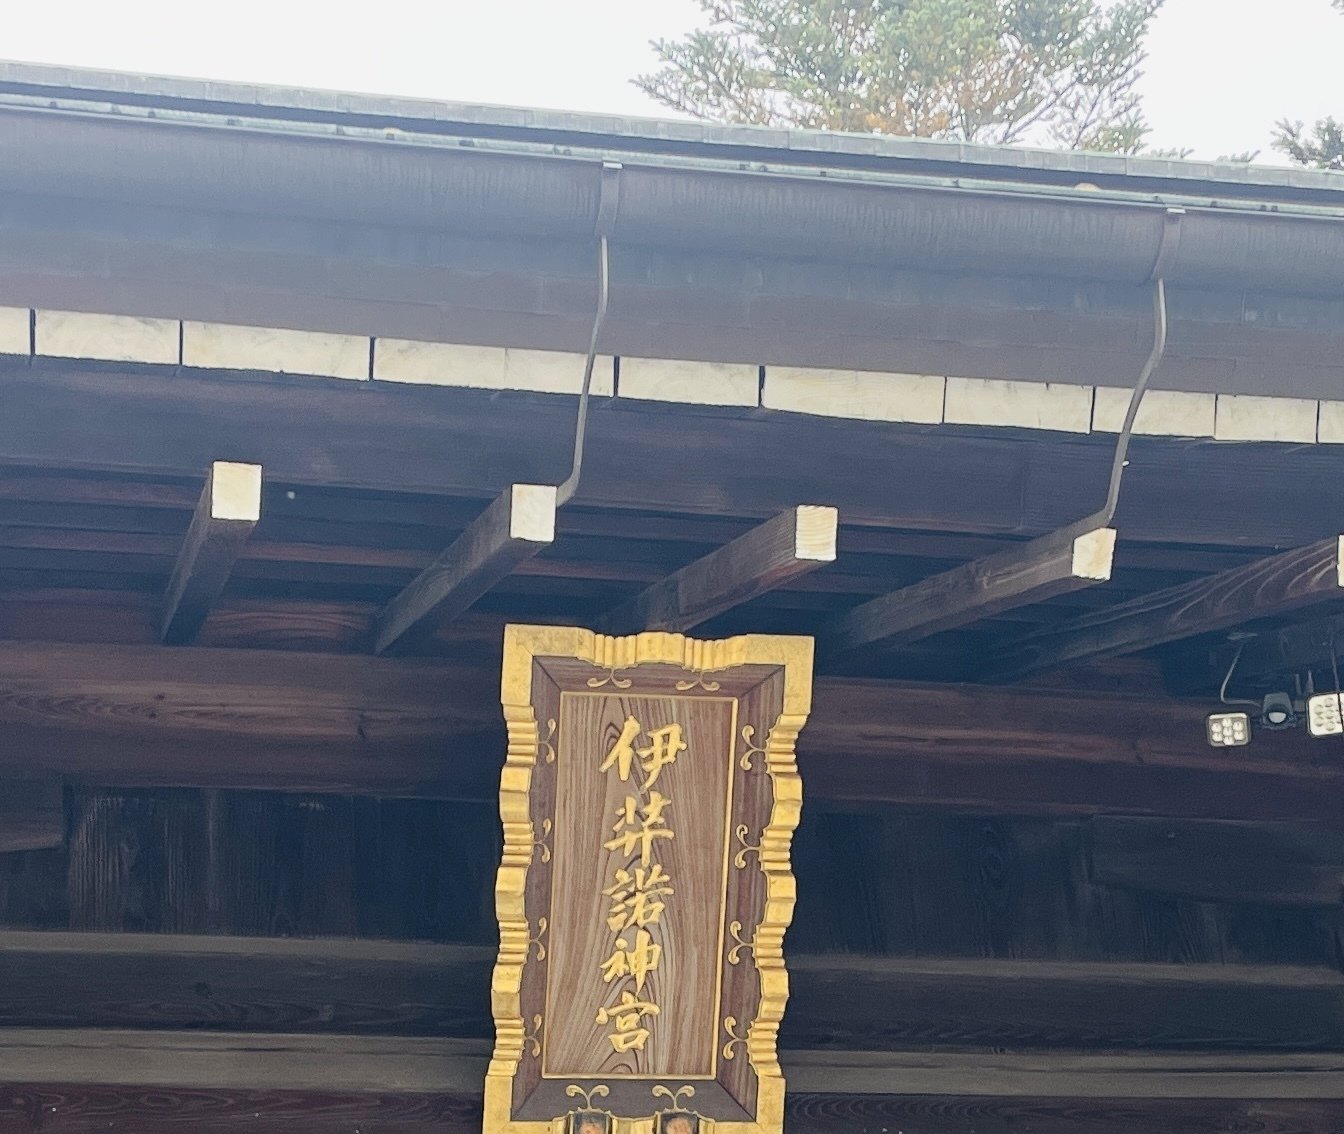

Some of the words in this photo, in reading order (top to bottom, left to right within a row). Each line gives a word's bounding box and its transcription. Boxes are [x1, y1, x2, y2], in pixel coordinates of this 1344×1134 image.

[596, 714, 688, 1054] 伊弉諾神宮
